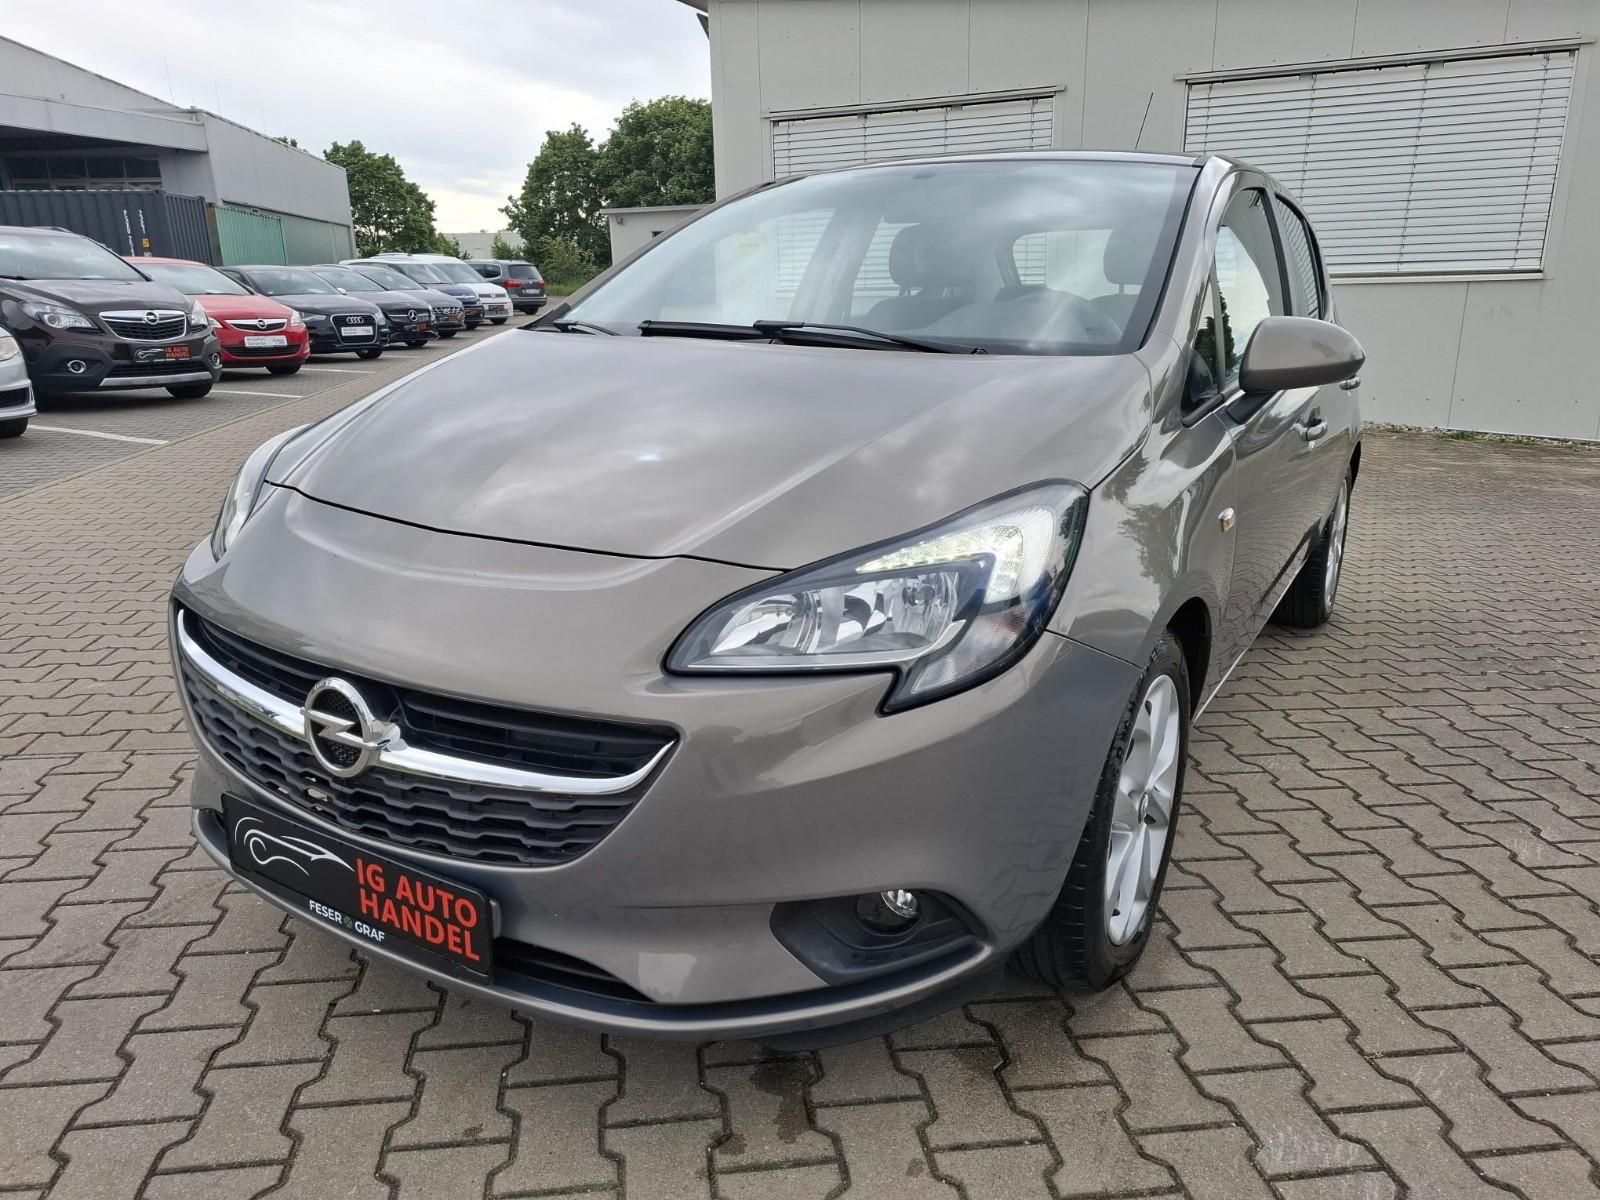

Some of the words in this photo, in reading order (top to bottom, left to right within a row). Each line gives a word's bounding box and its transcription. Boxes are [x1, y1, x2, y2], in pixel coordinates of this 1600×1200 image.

[309, 900, 343, 925] FESER
[354, 921, 386, 943] GRAF
[356, 858, 386, 893] IG
[396, 875, 478, 929] AUTO
[360, 888, 481, 961] HANDEL
